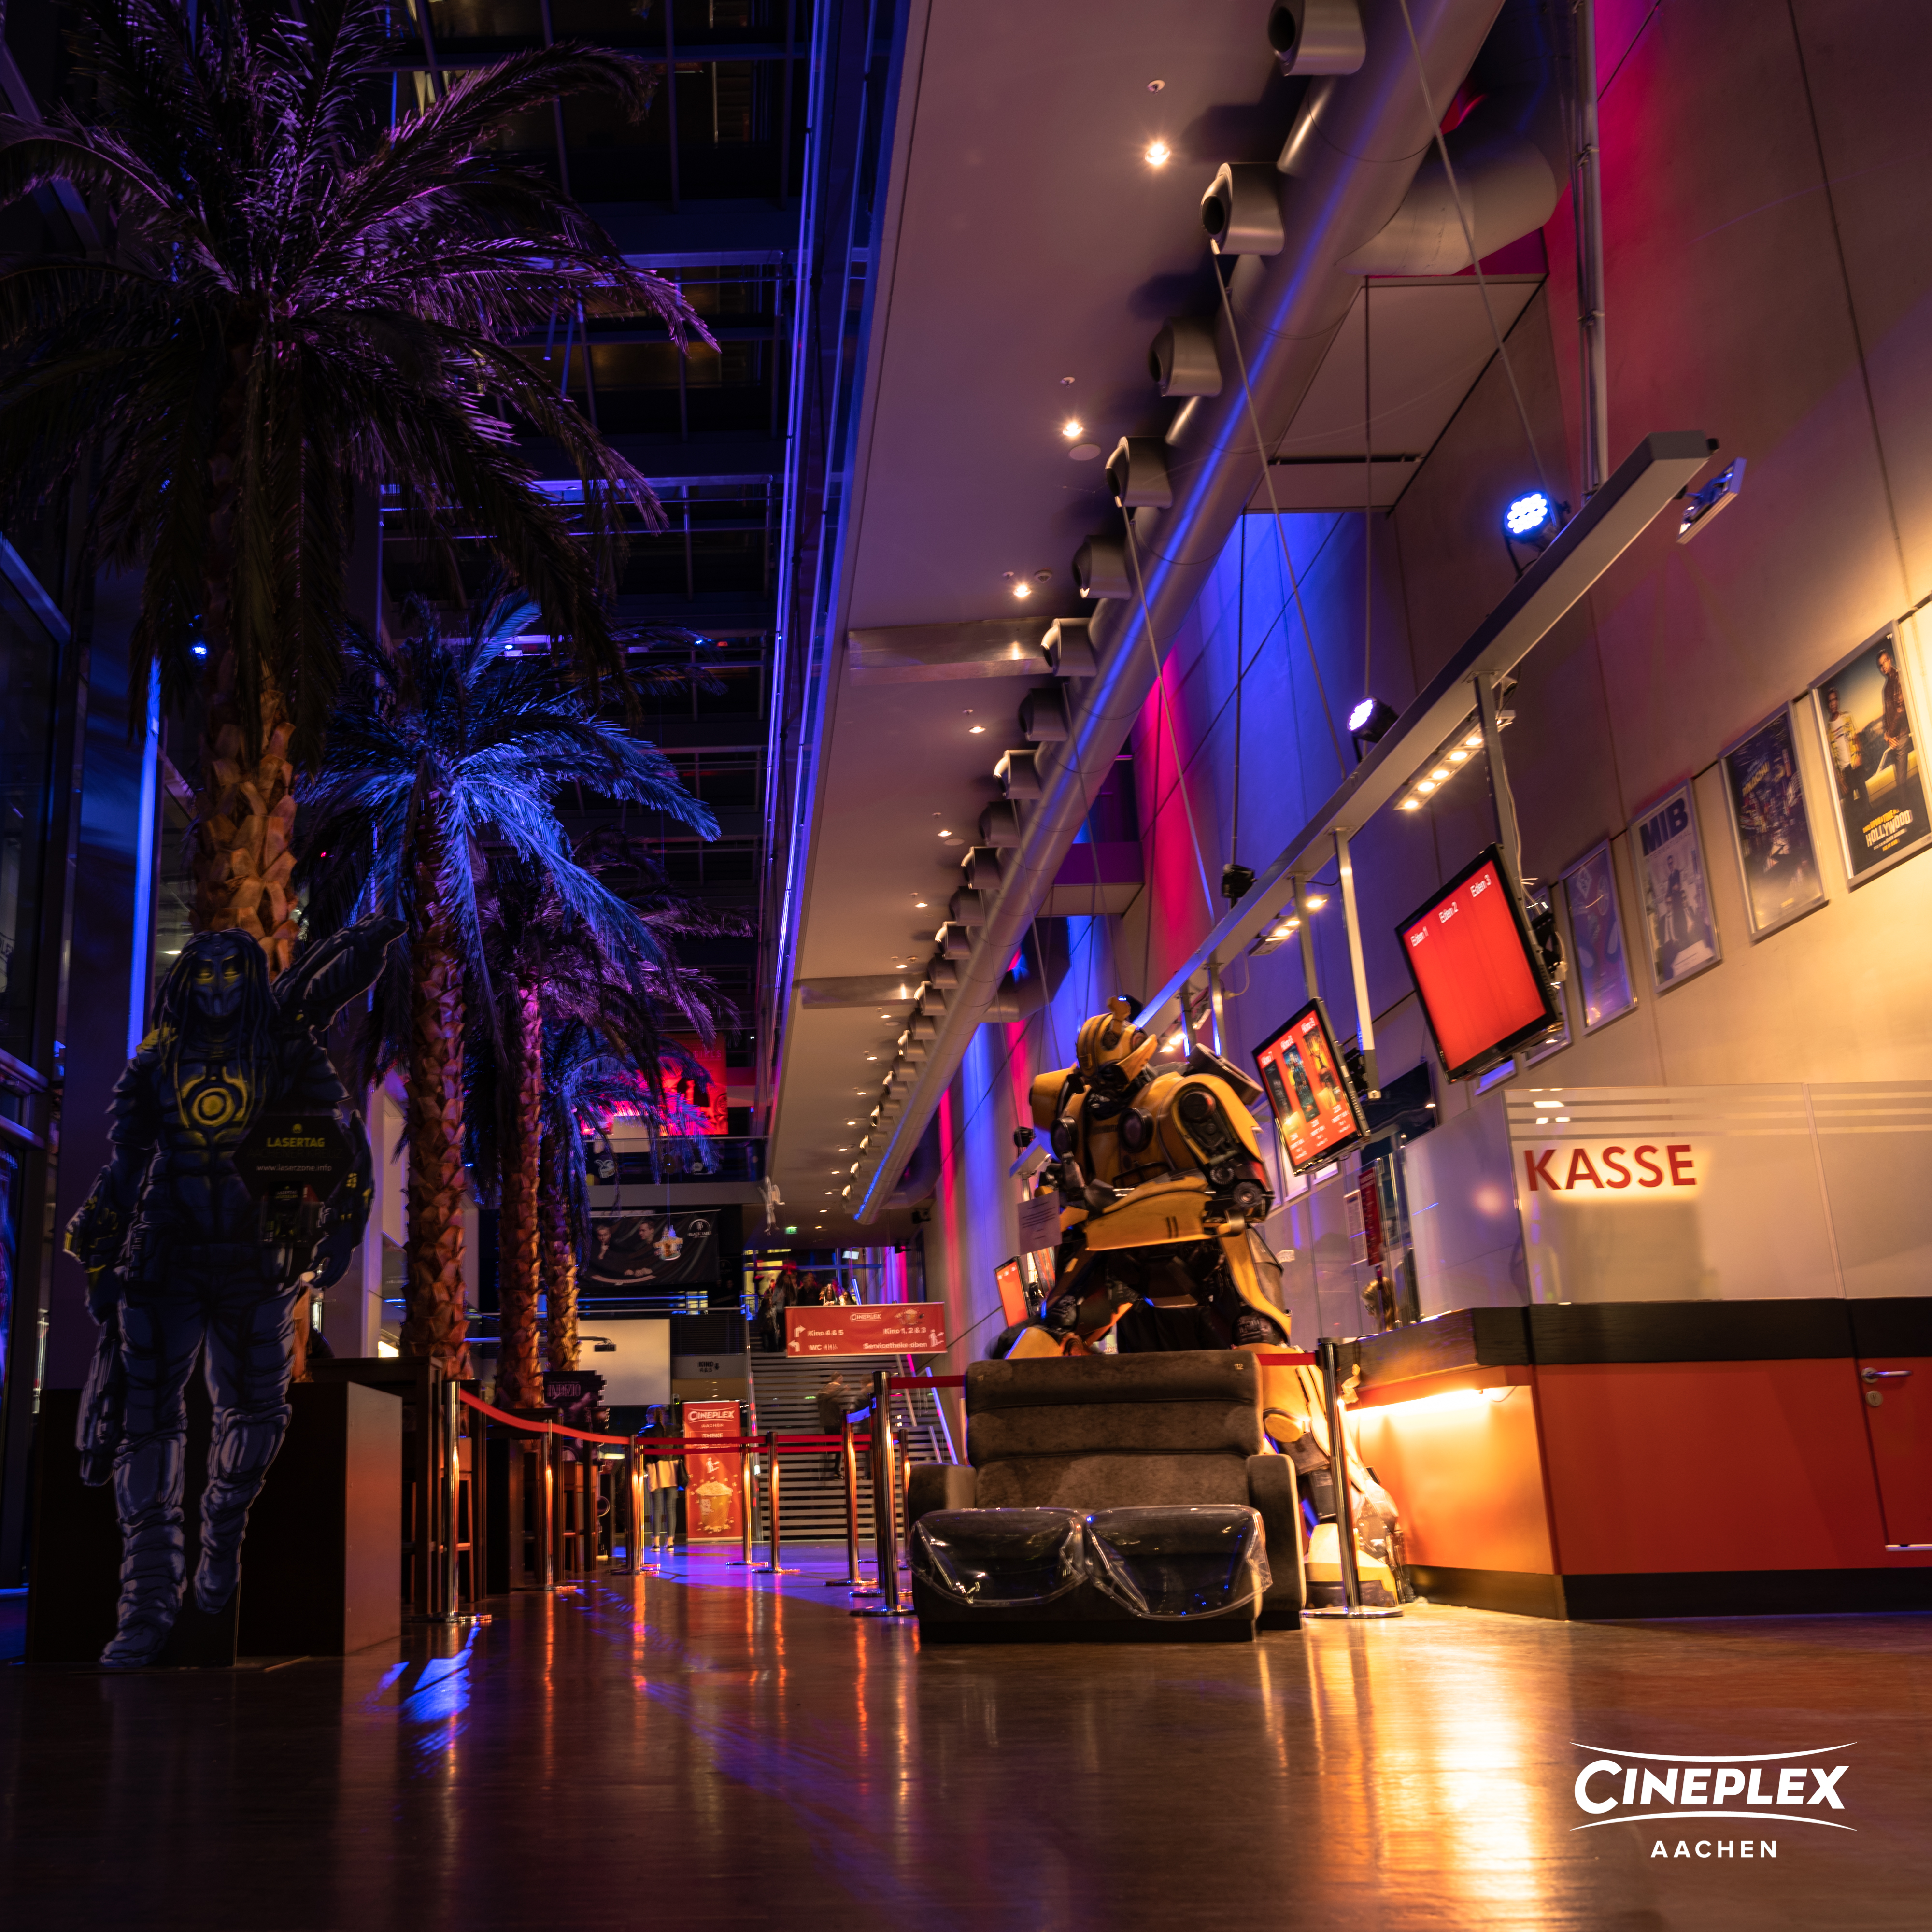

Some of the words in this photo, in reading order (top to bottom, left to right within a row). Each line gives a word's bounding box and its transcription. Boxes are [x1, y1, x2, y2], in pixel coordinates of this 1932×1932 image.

[1639, 798, 1688, 857] MIB
[1865, 809, 1913, 847] HOLLYWOOD
[1484, 874, 1492, 886] 3
[1451, 901, 1459, 913] 2
[1422, 926, 1429, 937] 1
[266, 1137, 325, 1148] LASERTAG
[247, 1148, 304, 1158] AACHENER
[307, 1148, 343, 1158] KREUZ
[256, 1164, 332, 1172] www.laserzone.info
[1523, 1144, 1697, 1191] KASSE
[688, 1410, 735, 1421] CINEPLEX
